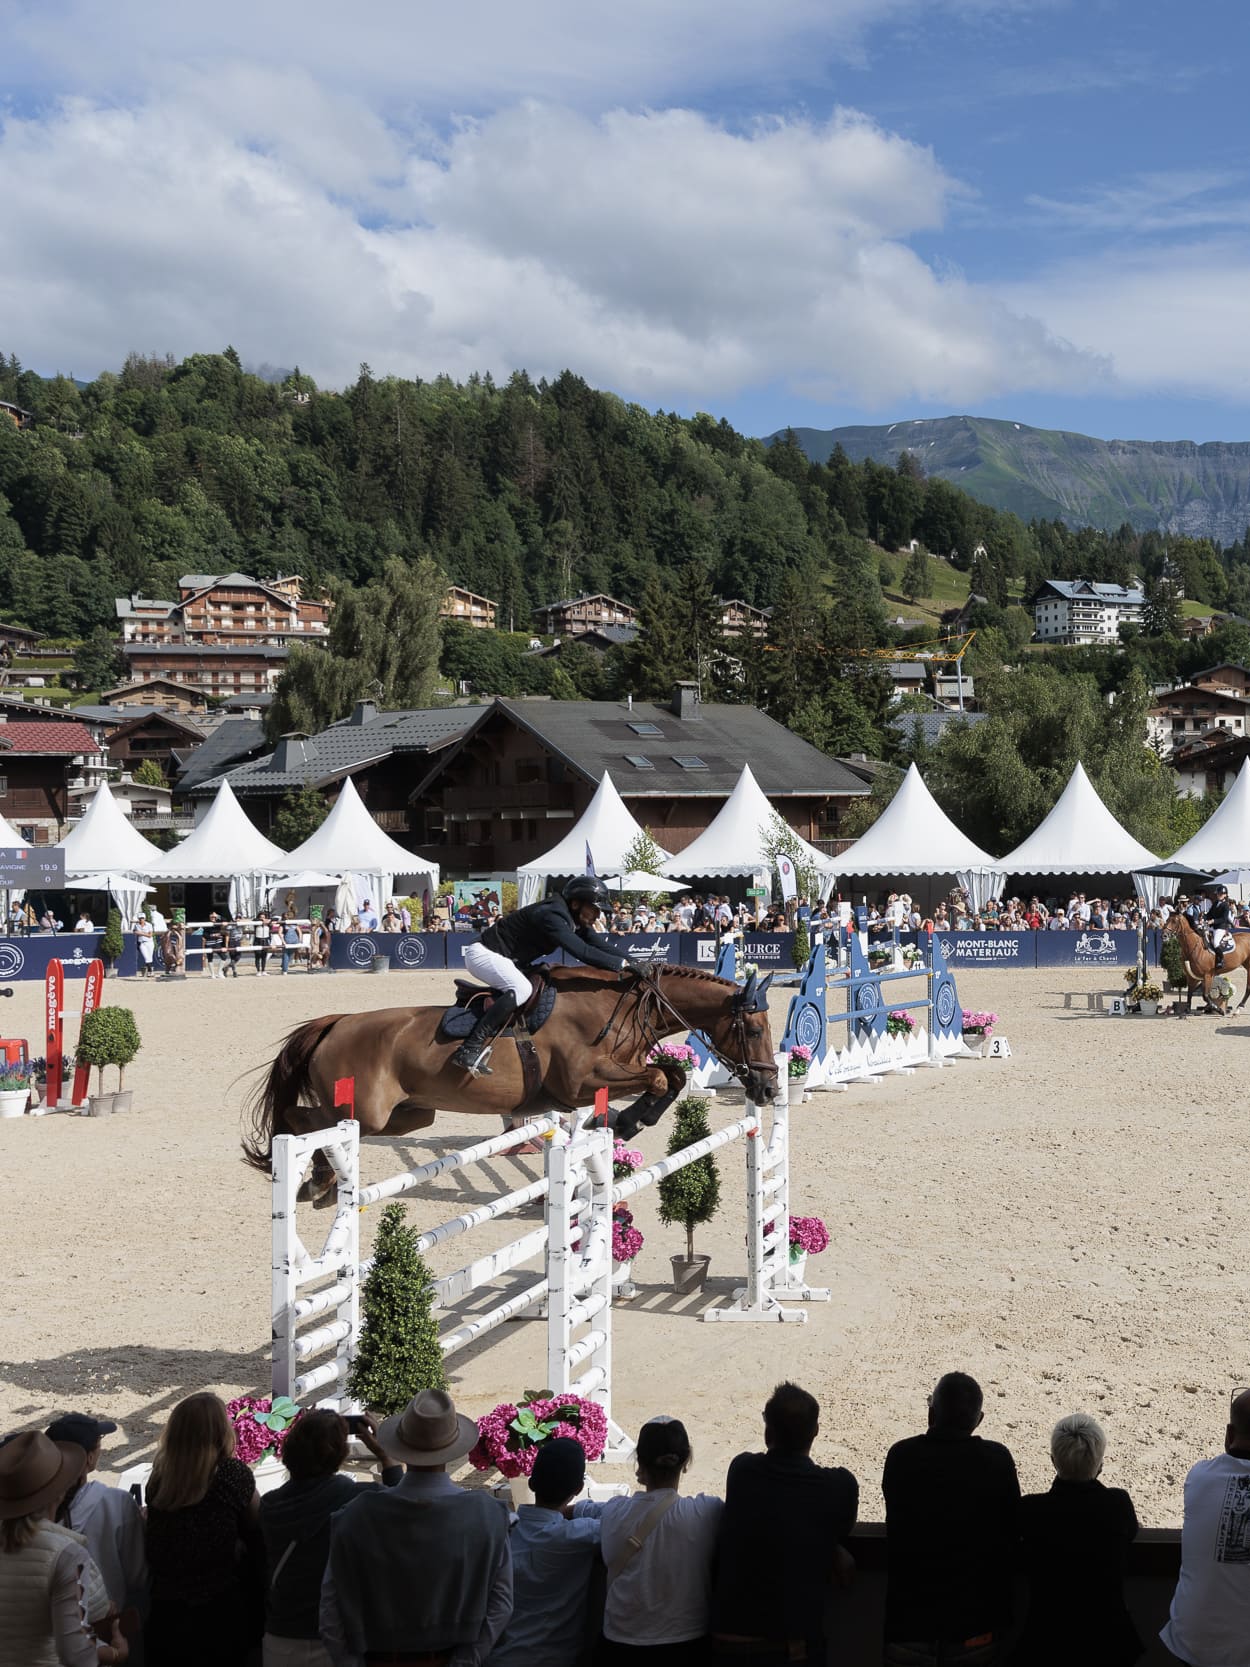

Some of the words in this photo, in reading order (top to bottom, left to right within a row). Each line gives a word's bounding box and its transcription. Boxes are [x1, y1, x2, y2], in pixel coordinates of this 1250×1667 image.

[956, 940, 1019, 948] MONT-BLANC
[956, 948, 1018, 956] MATERIAUX
[84, 975, 96, 1014] egève
[1113, 1000, 1121, 1012] B
[993, 1040, 1000, 1054] 3
